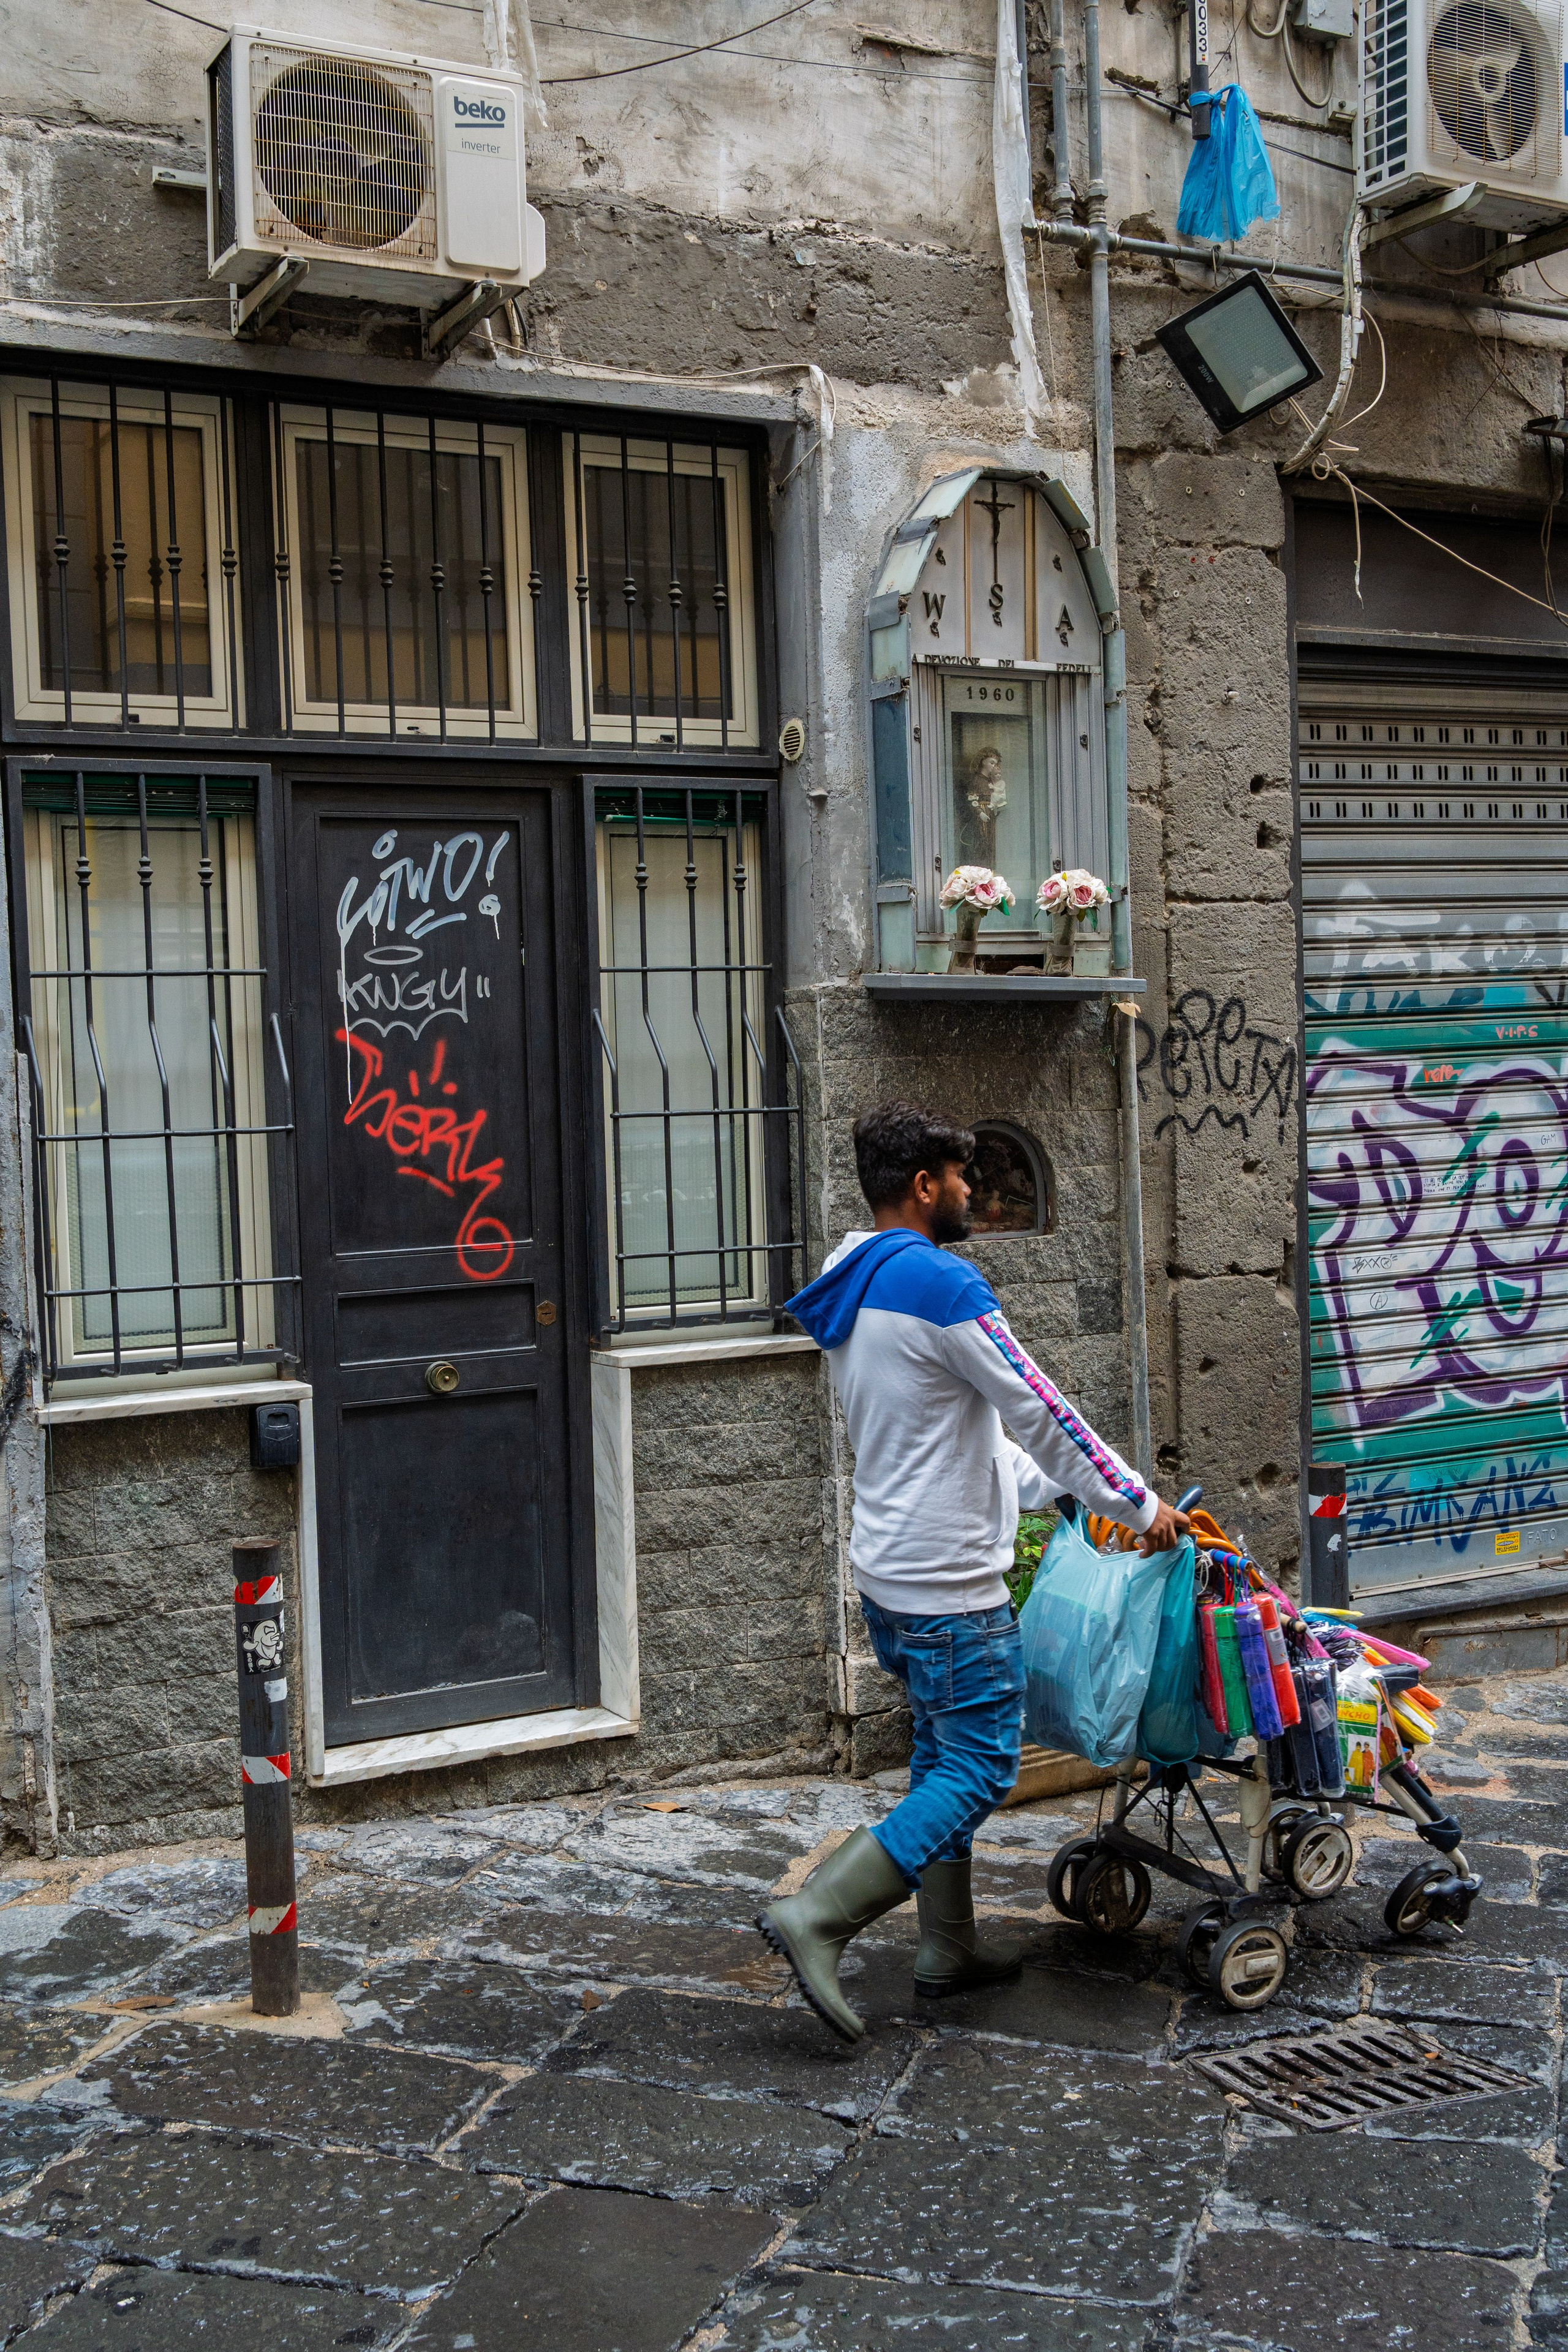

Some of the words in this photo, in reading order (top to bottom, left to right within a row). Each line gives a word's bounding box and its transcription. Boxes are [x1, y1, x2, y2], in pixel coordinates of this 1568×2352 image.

[1198, 0, 1207, 53] 033
[454, 96, 506, 122] beko
[461, 138, 501, 154] inverter
[922, 592, 946, 620] W
[989, 582, 1003, 609] S
[1055, 604, 1074, 631] A
[924, 654, 980, 666] DEVOZIONE
[998, 659, 1014, 668] DEI
[1057, 663, 1091, 673] FEDELI
[967, 686, 1014, 701] 1960
[1540, 1133, 1556, 1145] GAM
